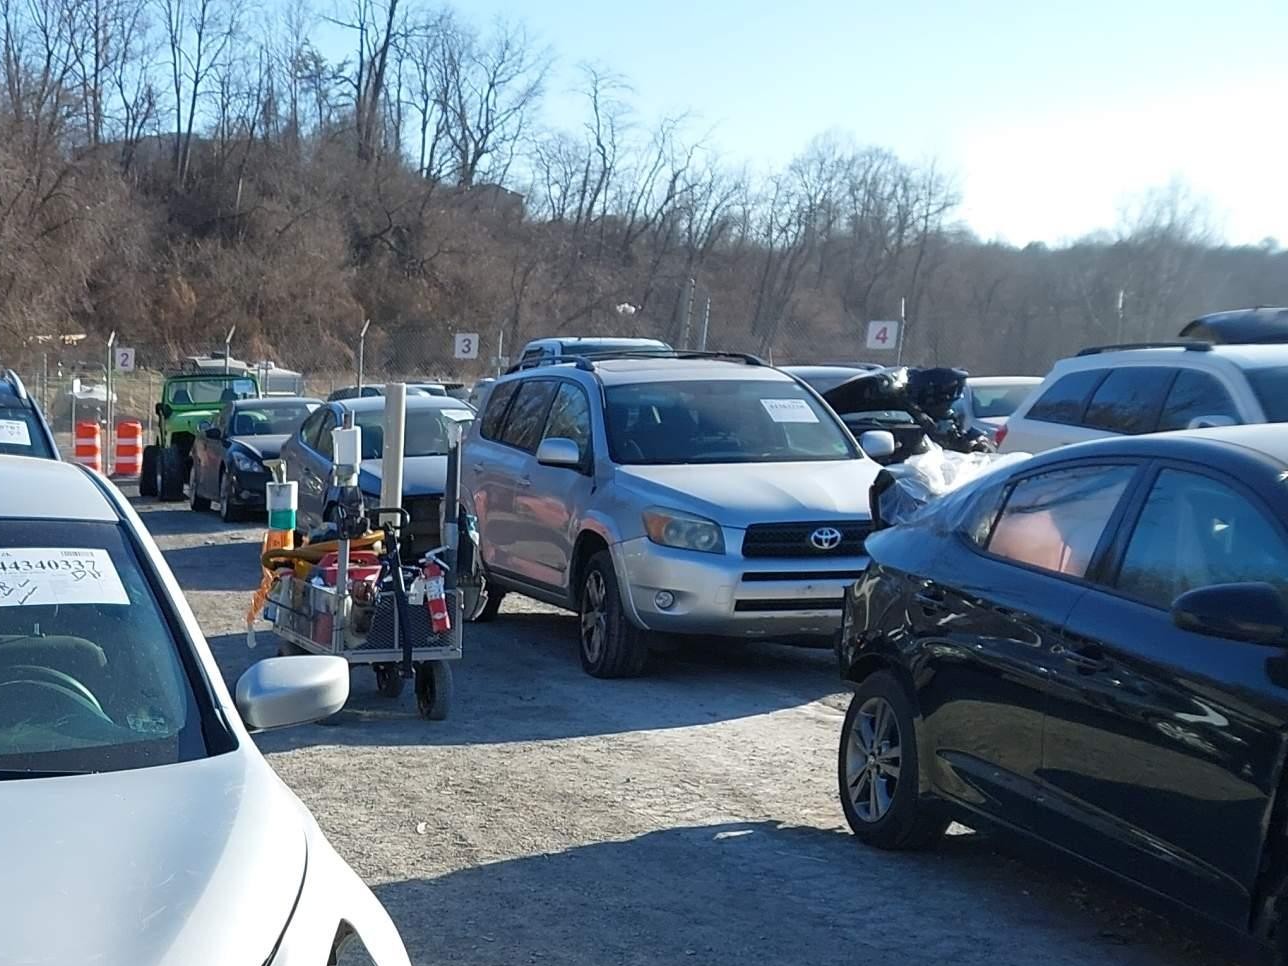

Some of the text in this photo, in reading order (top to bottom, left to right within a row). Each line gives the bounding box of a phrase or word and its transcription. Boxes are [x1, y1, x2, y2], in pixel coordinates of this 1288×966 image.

[876, 327, 888, 344] 4
[462, 338, 472, 354] 3
[120, 352, 129, 367] 2
